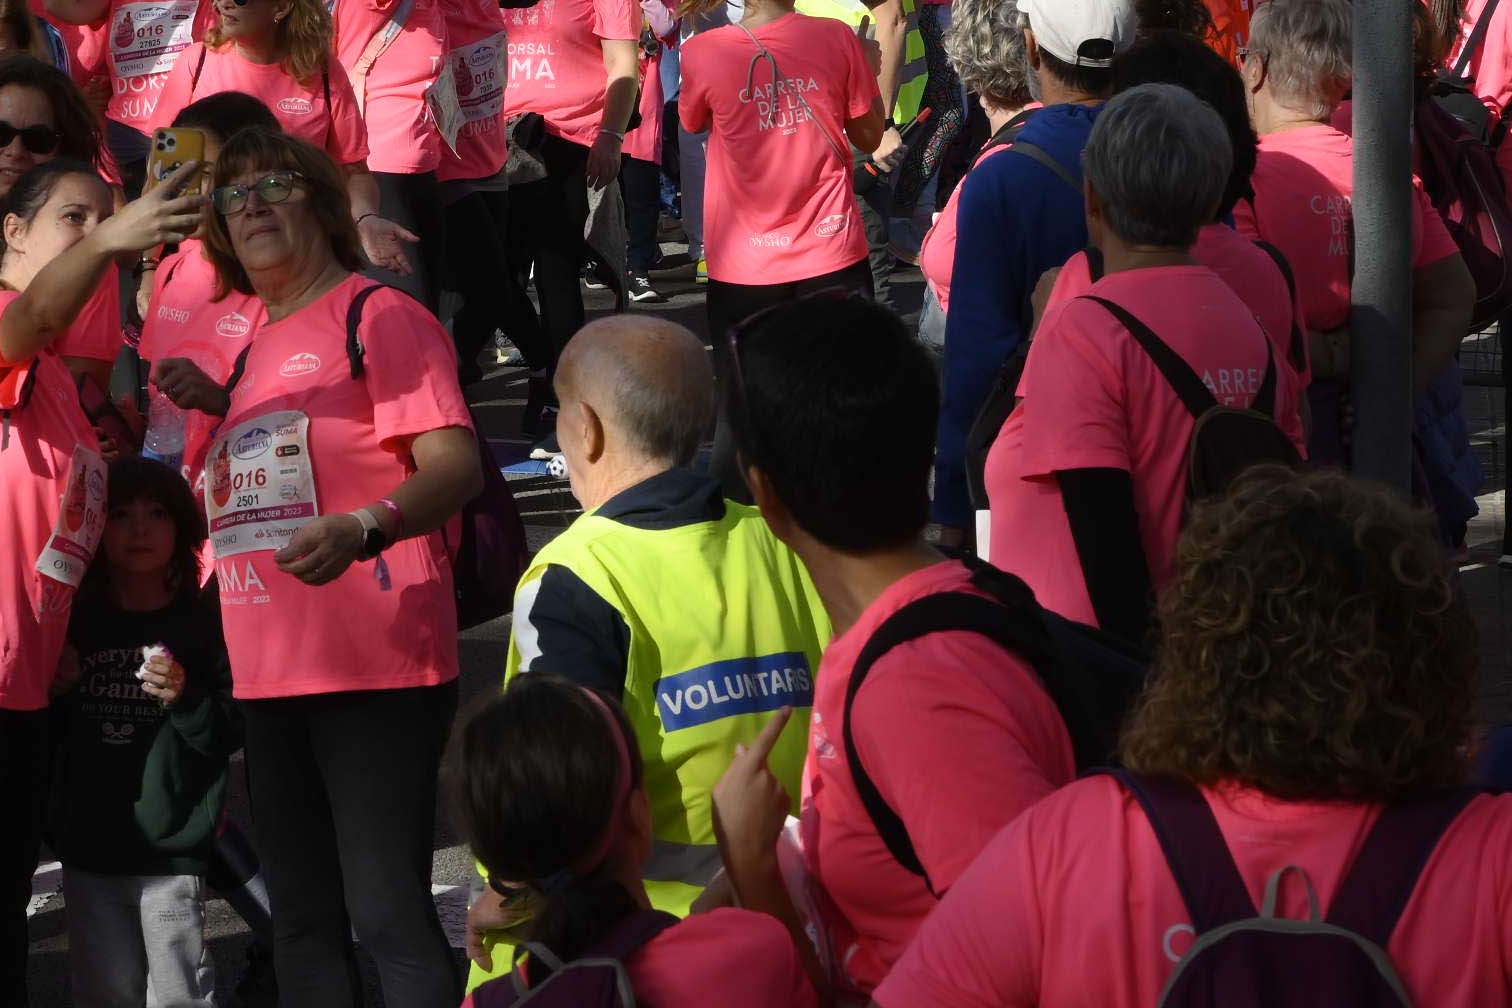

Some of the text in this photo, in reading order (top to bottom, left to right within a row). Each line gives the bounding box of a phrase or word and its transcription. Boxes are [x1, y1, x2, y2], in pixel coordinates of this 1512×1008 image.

[137, 25, 164, 38] 016
[508, 43, 555, 55] ORSAL
[511, 58, 555, 80] MA
[117, 72, 168, 94] DORS
[739, 77, 820, 103] CARRERA
[121, 98, 158, 118] SUM
[1202, 369, 1265, 394] ARRE
[233, 467, 267, 490] 016
[236, 493, 259, 508] 2501
